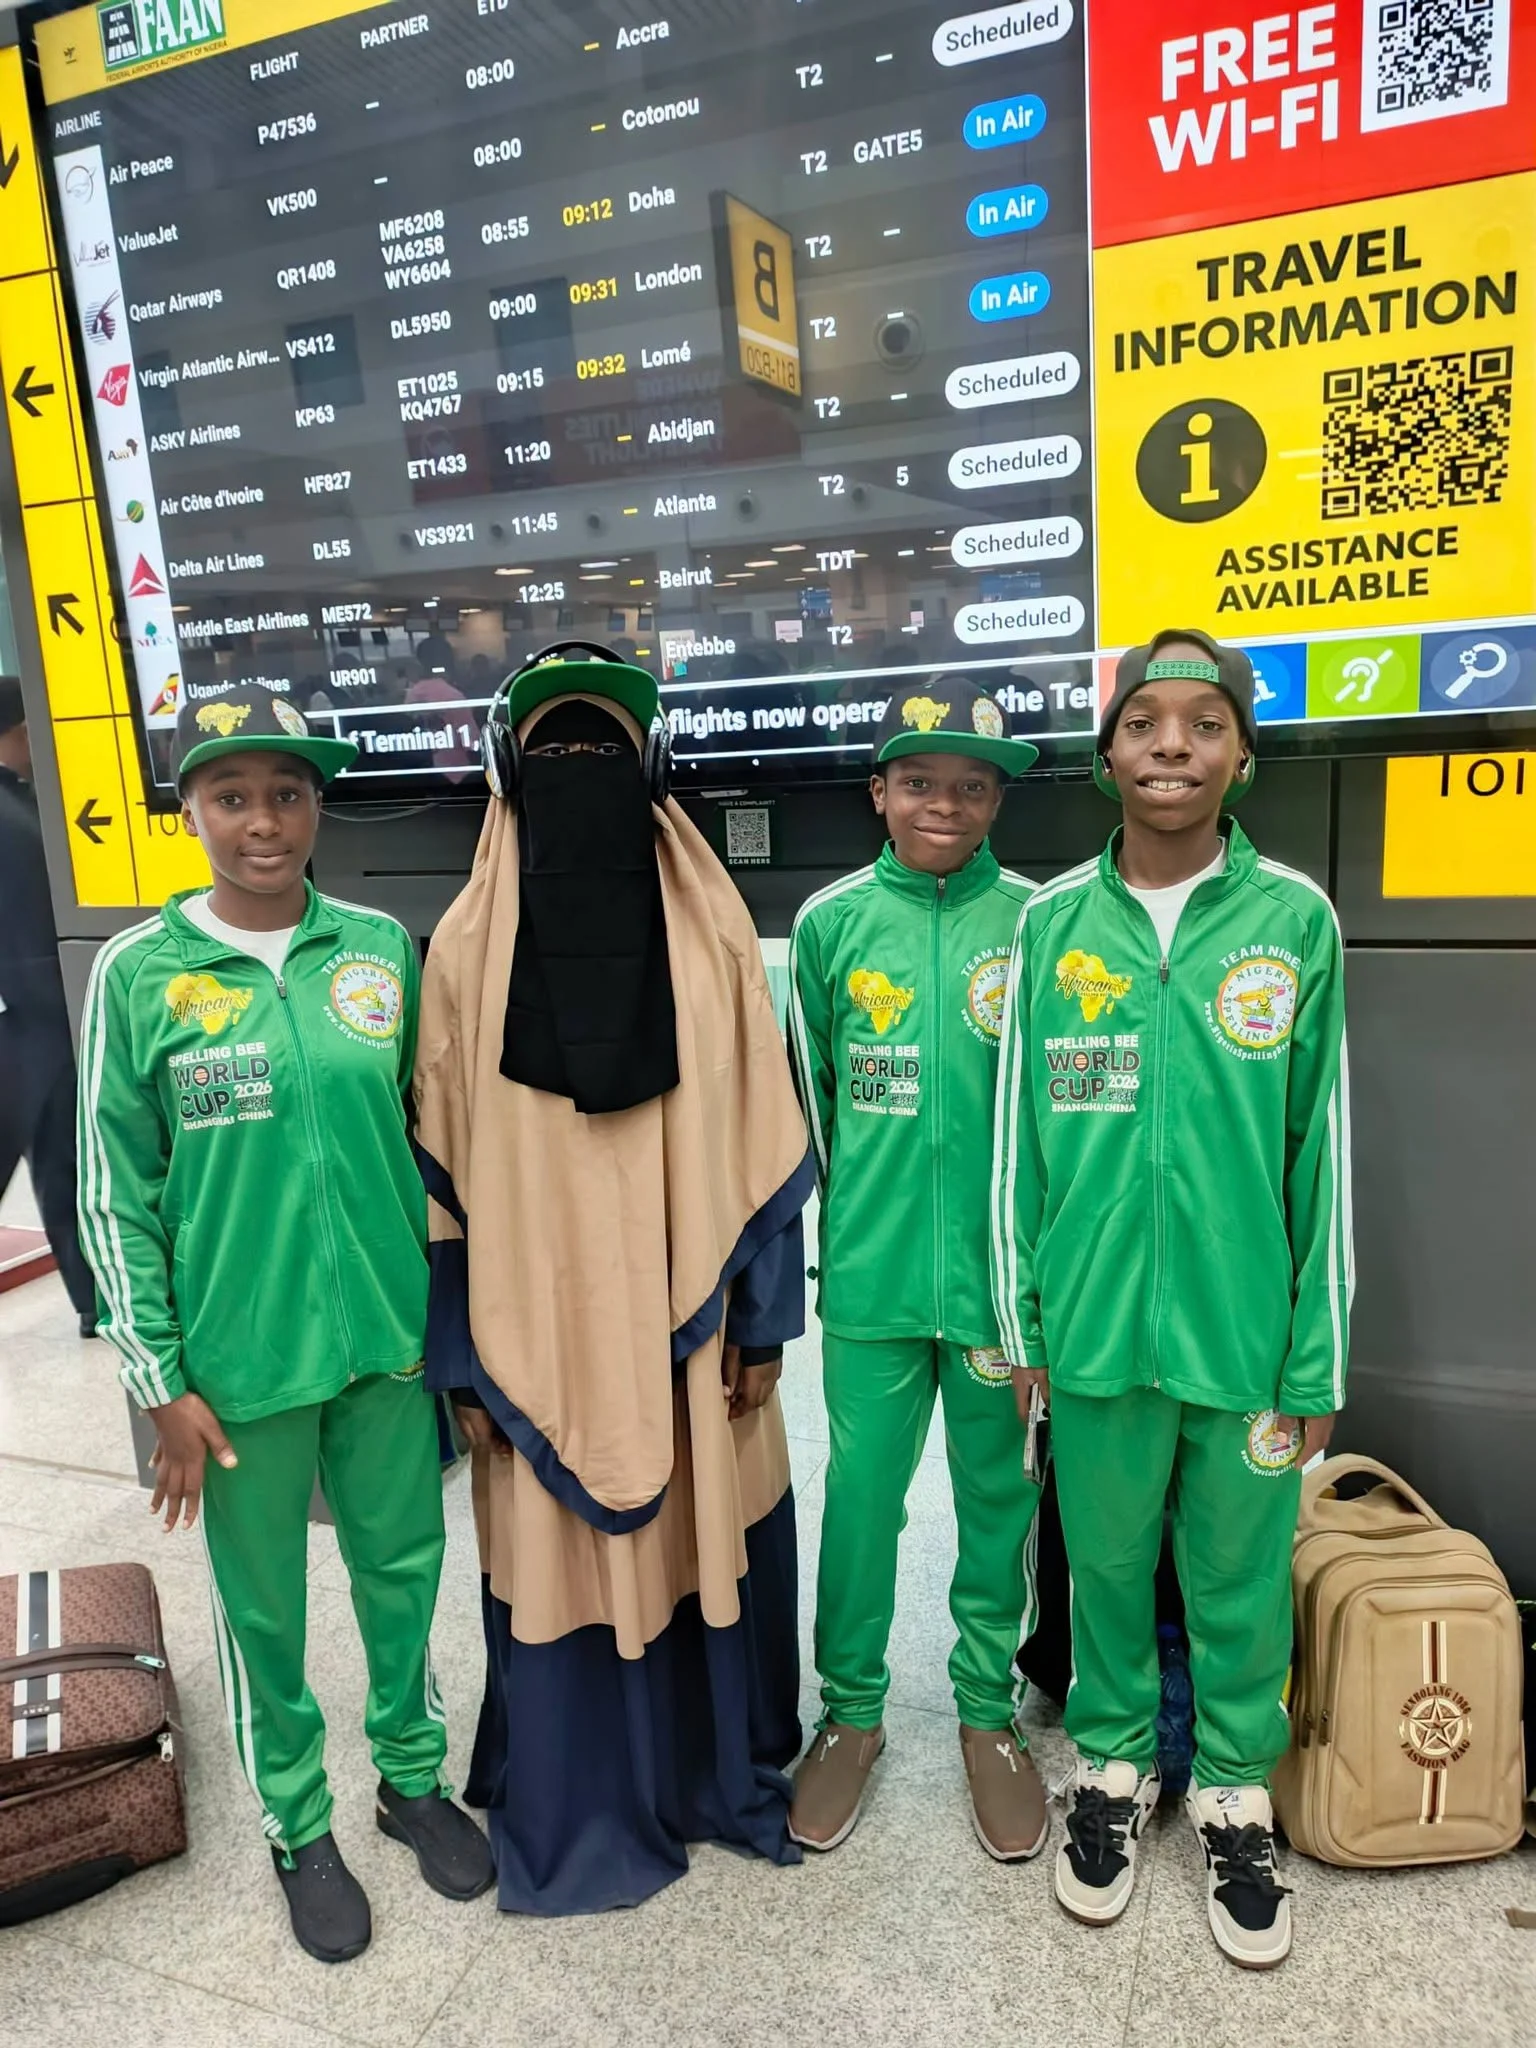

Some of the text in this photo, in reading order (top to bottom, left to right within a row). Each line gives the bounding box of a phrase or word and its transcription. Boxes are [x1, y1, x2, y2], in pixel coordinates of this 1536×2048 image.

[135, 0, 223, 56] FAAN
[361, 15, 429, 48] PARTNER
[616, 21, 669, 49] Accra
[945, 5, 1060, 52] Scheduled
[131, 60, 159, 75] AIRPORTS
[193, 45, 203, 57] OF
[250, 52, 298, 80] FLIGHT
[1161, 4, 1336, 102] FREE
[466, 59, 514, 88] 08:00
[796, 64, 823, 88] T2
[55, 110, 102, 138] AIRLINE
[623, 98, 699, 130] Cotonou
[975, 108, 1033, 137] In Air
[1148, 79, 1339, 173] WI-FI
[258, 113, 316, 144] P47536
[474, 138, 521, 166] 08:00
[854, 129, 922, 163] GATE5
[110, 156, 173, 184] Air Peace
[801, 151, 827, 174] T2
[267, 189, 317, 216] VK500
[563, 199, 612, 226] 09:12
[629, 186, 675, 212] Doha
[978, 196, 1036, 225] In Air
[118, 224, 178, 252] ValueJet
[380, 210, 444, 243] MF6208
[482, 216, 529, 244] 08:55
[382, 236, 446, 265] VA6258
[805, 235, 832, 258] T2
[277, 260, 336, 289] QR1408
[385, 259, 451, 289] WY6604
[1197, 225, 1422, 302] TRAVEL
[570, 278, 616, 304] 09:31
[635, 264, 702, 291] London
[130, 289, 222, 321] Qatar Airways
[489, 294, 536, 320] 09:00
[981, 283, 1038, 312] In Air
[391, 311, 451, 338] DL5950
[810, 317, 836, 339] T2
[1114, 271, 1517, 373] INFORMATION
[286, 334, 335, 358] VS412
[642, 341, 691, 368] Lomé
[139, 345, 280, 390] Virgin Atlantic Airw...
[577, 354, 625, 379] 09:32
[958, 363, 1067, 395] Scheduled
[397, 371, 458, 398] ET1025
[497, 368, 543, 393] 09:15
[296, 405, 334, 427] KP63
[401, 394, 461, 421] KQ4767
[814, 397, 840, 418] T2
[151, 425, 240, 452] ASKY Airlines
[648, 418, 714, 443] Abidjan
[505, 441, 550, 464] 11:20
[960, 446, 1068, 477] Scheduled
[408, 454, 466, 479] ET1433
[897, 466, 908, 486] 5
[305, 471, 350, 494] HF827
[819, 475, 844, 495] T2
[161, 487, 263, 515] Air Côte d'Ivoire
[654, 494, 716, 517] Atlanta
[415, 523, 473, 546] VS3921
[512, 512, 557, 534] 11:45
[313, 540, 350, 560] DL55
[963, 527, 1070, 556] Scheduled
[1216, 525, 1458, 577] ASSISTANCE
[169, 554, 264, 577] Delta Air Lines
[816, 550, 855, 572] TDT
[660, 567, 712, 588] Beirut
[1216, 568, 1429, 613] AVAILABLE
[519, 582, 564, 603] 12:25
[179, 612, 309, 638] Middle East Airlines
[322, 603, 372, 623] ME572
[966, 606, 1072, 633] Scheduled
[665, 636, 736, 657] Entebbe
[827, 626, 853, 644] T2
[330, 668, 376, 687] UR901
[360, 724, 454, 752] Terminal
[458, 724, 483, 751] 1,
[669, 706, 747, 740] flights
[753, 707, 805, 729] now
[812, 699, 893, 731] opera
[995, 684, 1045, 713] the
[321, 951, 353, 975] TEAM
[961, 948, 993, 977] TEAM
[1219, 944, 1301, 972] TEAM NIGE
[1056, 973, 1112, 1000] African
[1236, 965, 1294, 992] NIGERIA
[172, 997, 233, 1027] African
[1223, 996, 1271, 1041] SPELLING
[168, 1042, 266, 1068] SPELLING BEE
[848, 1043, 920, 1057] SPELLING BEE
[1044, 1034, 1139, 1050] SPELLING BEE
[173, 1057, 271, 1091] WORLD
[849, 1055, 921, 1079] WORLD
[1045, 1050, 1141, 1074] WORLD
[233, 1080, 273, 1100] 2026
[850, 1079, 887, 1104] CUP
[888, 1081, 920, 1094] 2026
[1048, 1077, 1106, 1102] CUP
[1107, 1074, 1141, 1089] 2026
[180, 1090, 230, 1119] CUP
[237, 1109, 274, 1121] CHINA
[888, 1107, 919, 1117] CHINA
[1104, 1103, 1137, 1112] CHINA
[1241, 1410, 1260, 1424] TE
[1400, 1739, 1471, 1769] FASHION BAG
